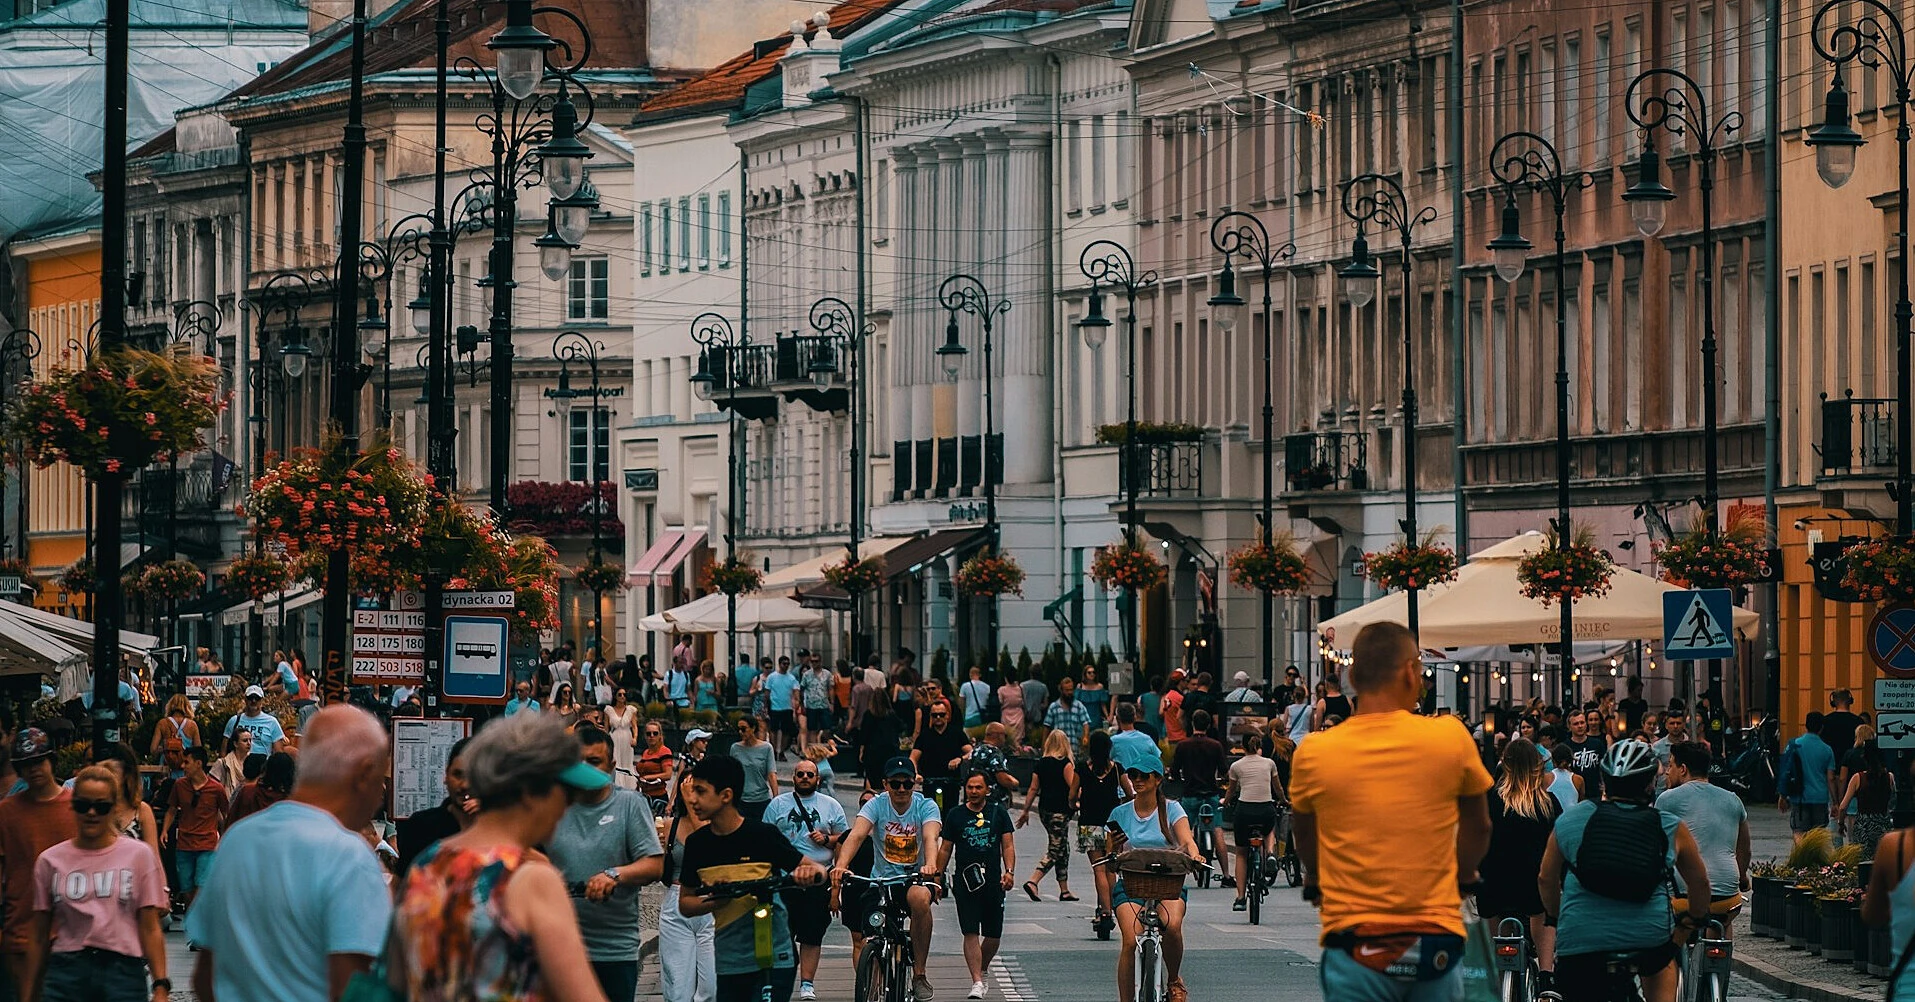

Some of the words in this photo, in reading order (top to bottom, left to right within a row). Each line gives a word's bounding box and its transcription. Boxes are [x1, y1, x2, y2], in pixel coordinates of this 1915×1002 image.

[498, 595, 513, 605] 02
[358, 614, 374, 624] E-2
[384, 614, 399, 625] 111
[408, 615, 424, 626] 116
[1540, 622, 1611, 634] GOINIEC
[357, 637, 375, 648] 128
[382, 638, 400, 648] 175
[406, 639, 424, 649] 180
[356, 661, 375, 671] 222
[380, 662, 399, 672] 503
[405, 662, 423, 673] 518
[51, 870, 133, 903] LOVE
